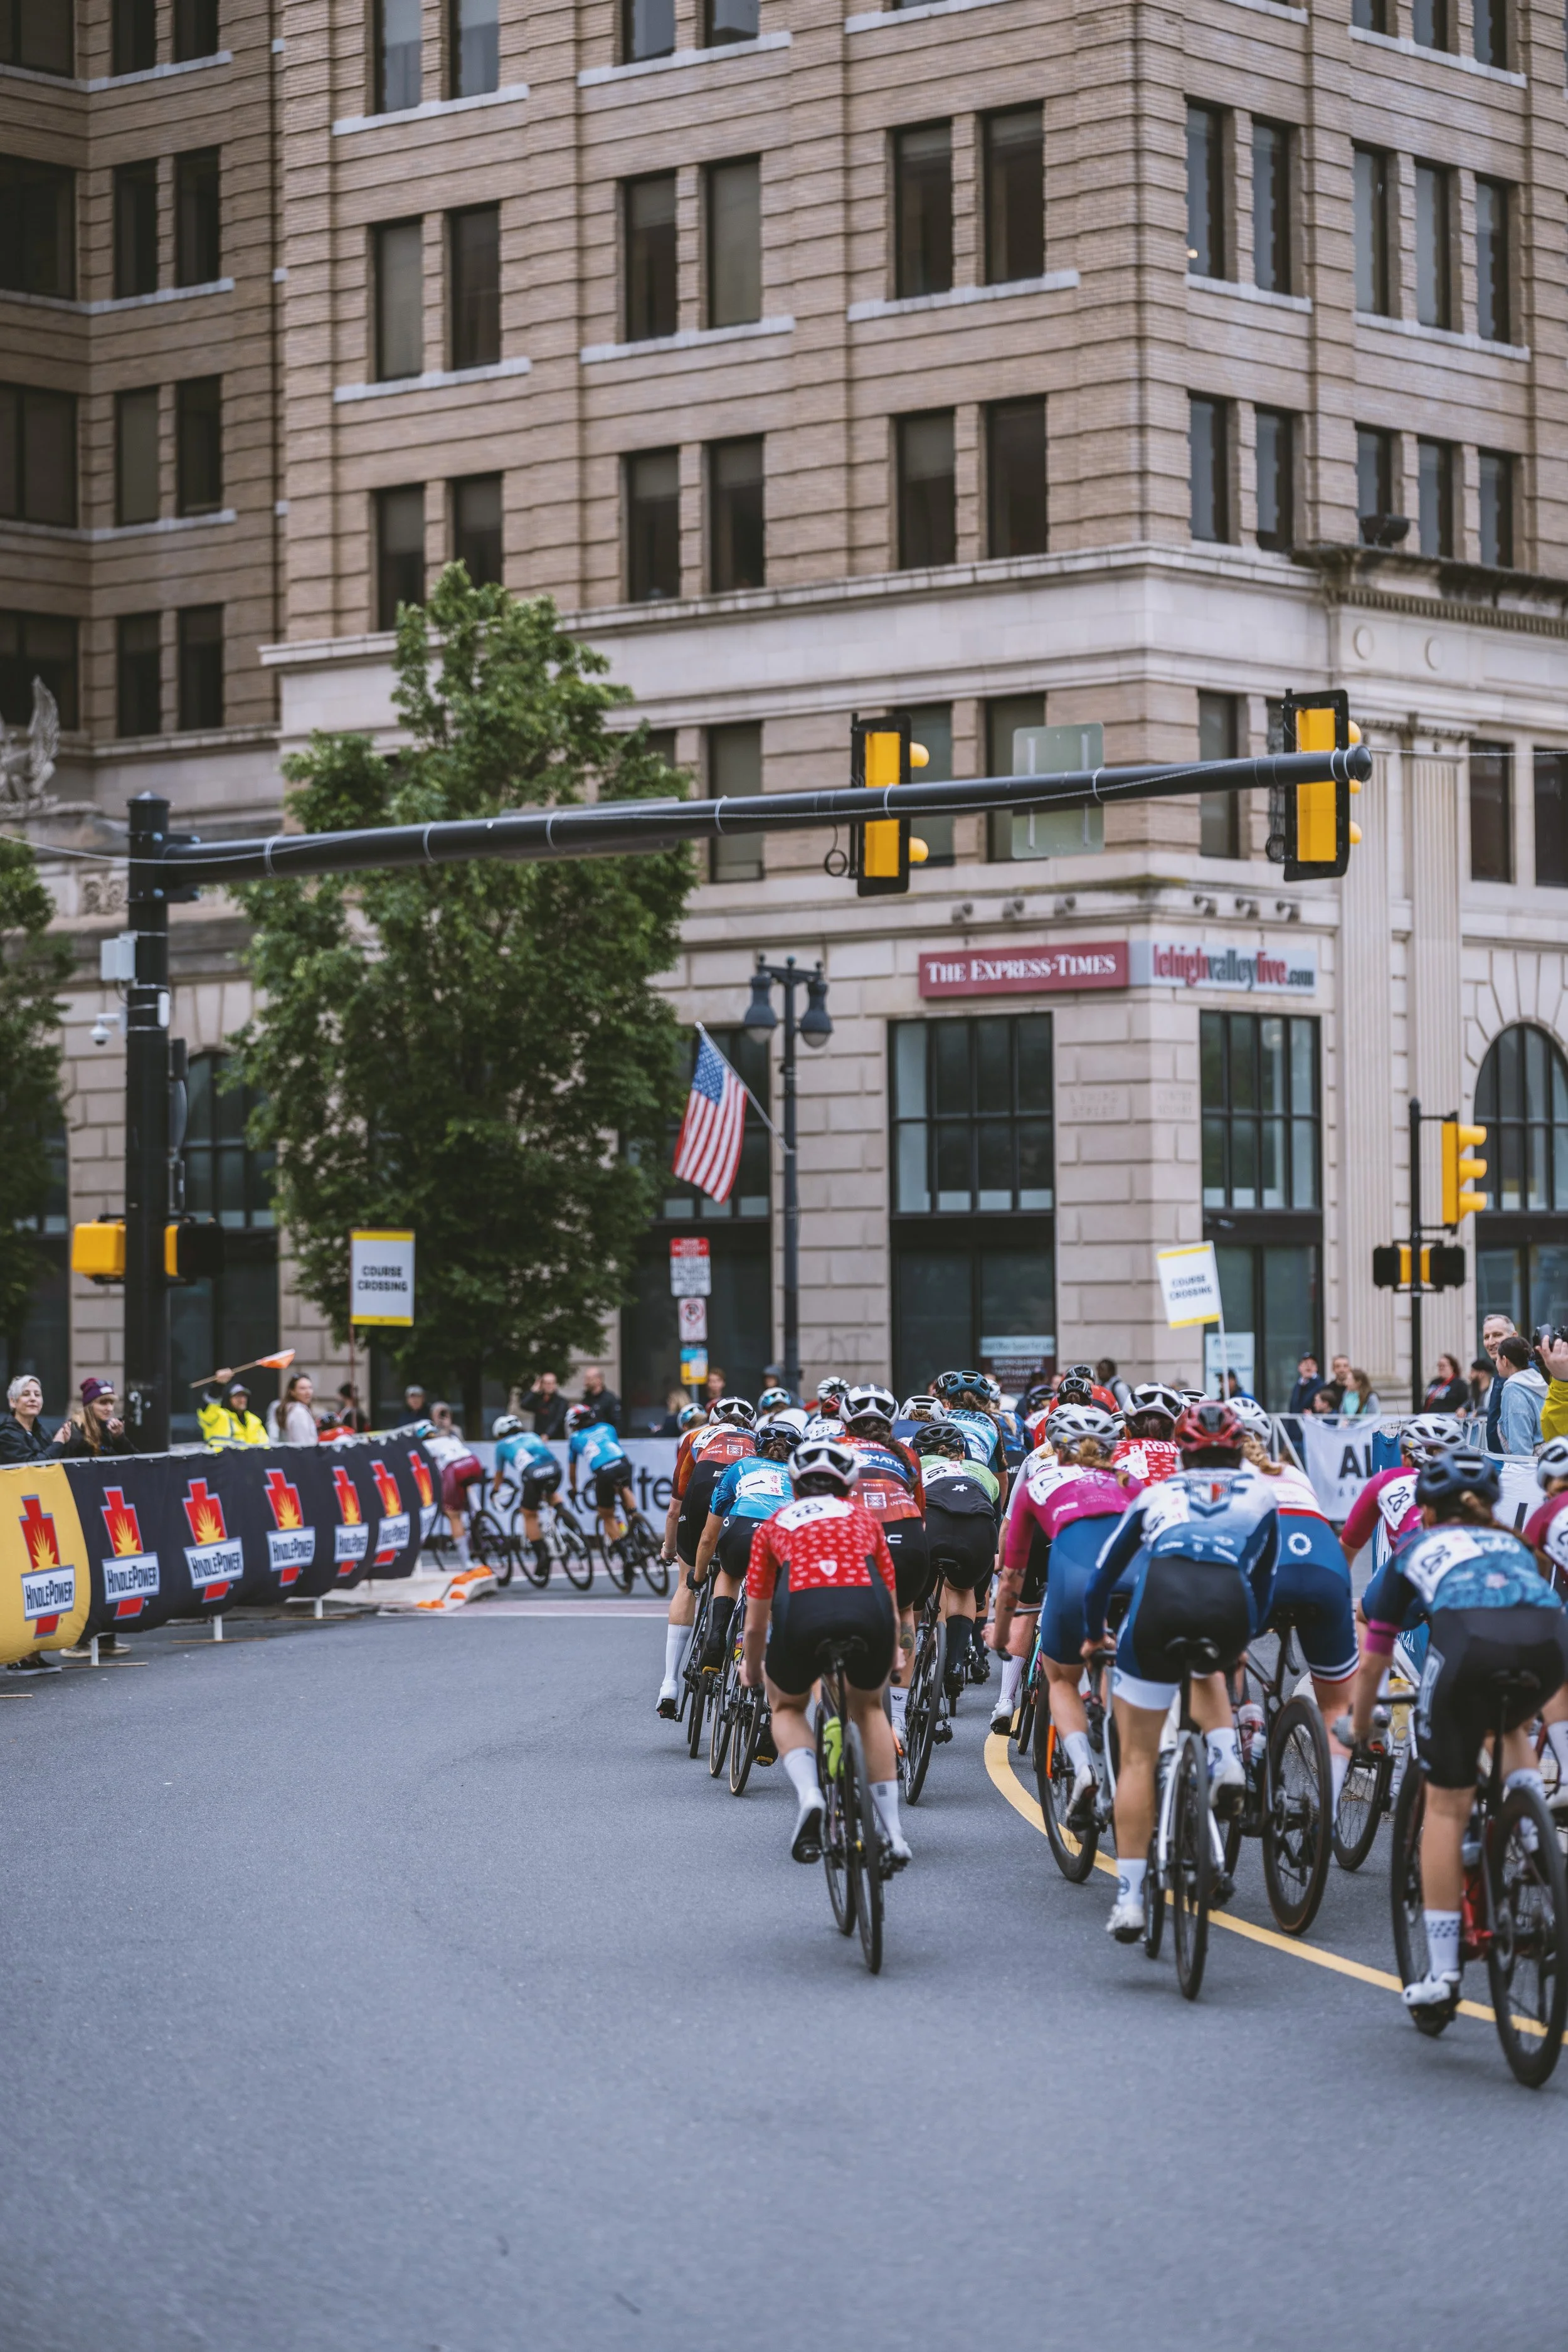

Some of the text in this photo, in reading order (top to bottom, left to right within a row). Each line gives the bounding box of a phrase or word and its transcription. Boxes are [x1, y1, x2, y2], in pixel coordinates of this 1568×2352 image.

[925, 961, 967, 983] THE
[362, 1265, 403, 1277] COURSE
[358, 1280, 408, 1292] CROSSING
[1172, 1274, 1205, 1287] COURSE
[1169, 1285, 1212, 1300] CROSSING
[1129, 1441, 1180, 1455] RACIN
[1387, 1486, 1411, 1513] 28
